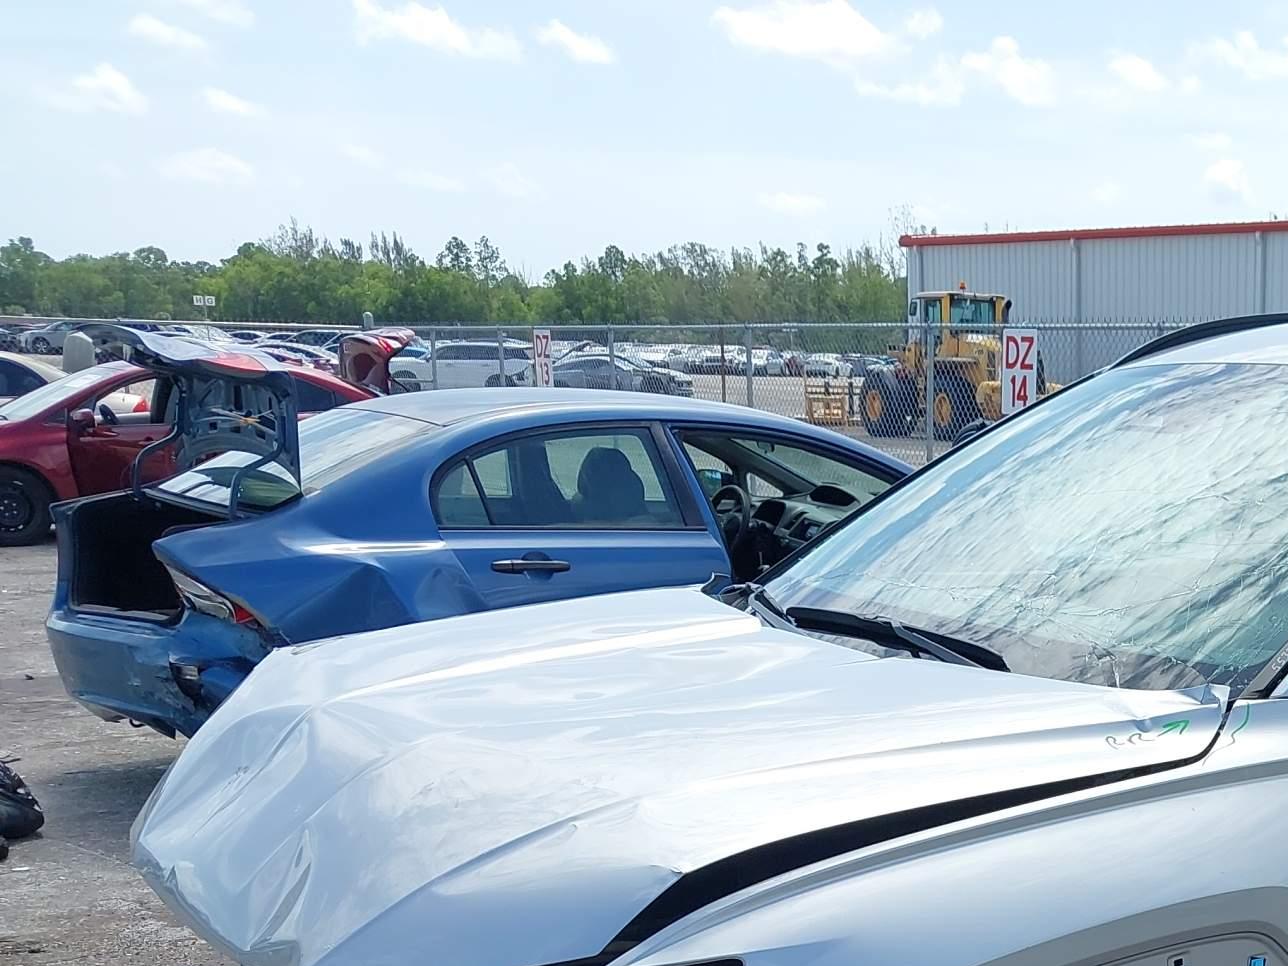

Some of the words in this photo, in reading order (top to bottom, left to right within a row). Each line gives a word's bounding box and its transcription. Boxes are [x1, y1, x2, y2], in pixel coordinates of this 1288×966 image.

[535, 335, 551, 359] DZ
[1005, 335, 1035, 371] DZ
[540, 362, 551, 386] 13
[1010, 374, 1029, 408] 14
